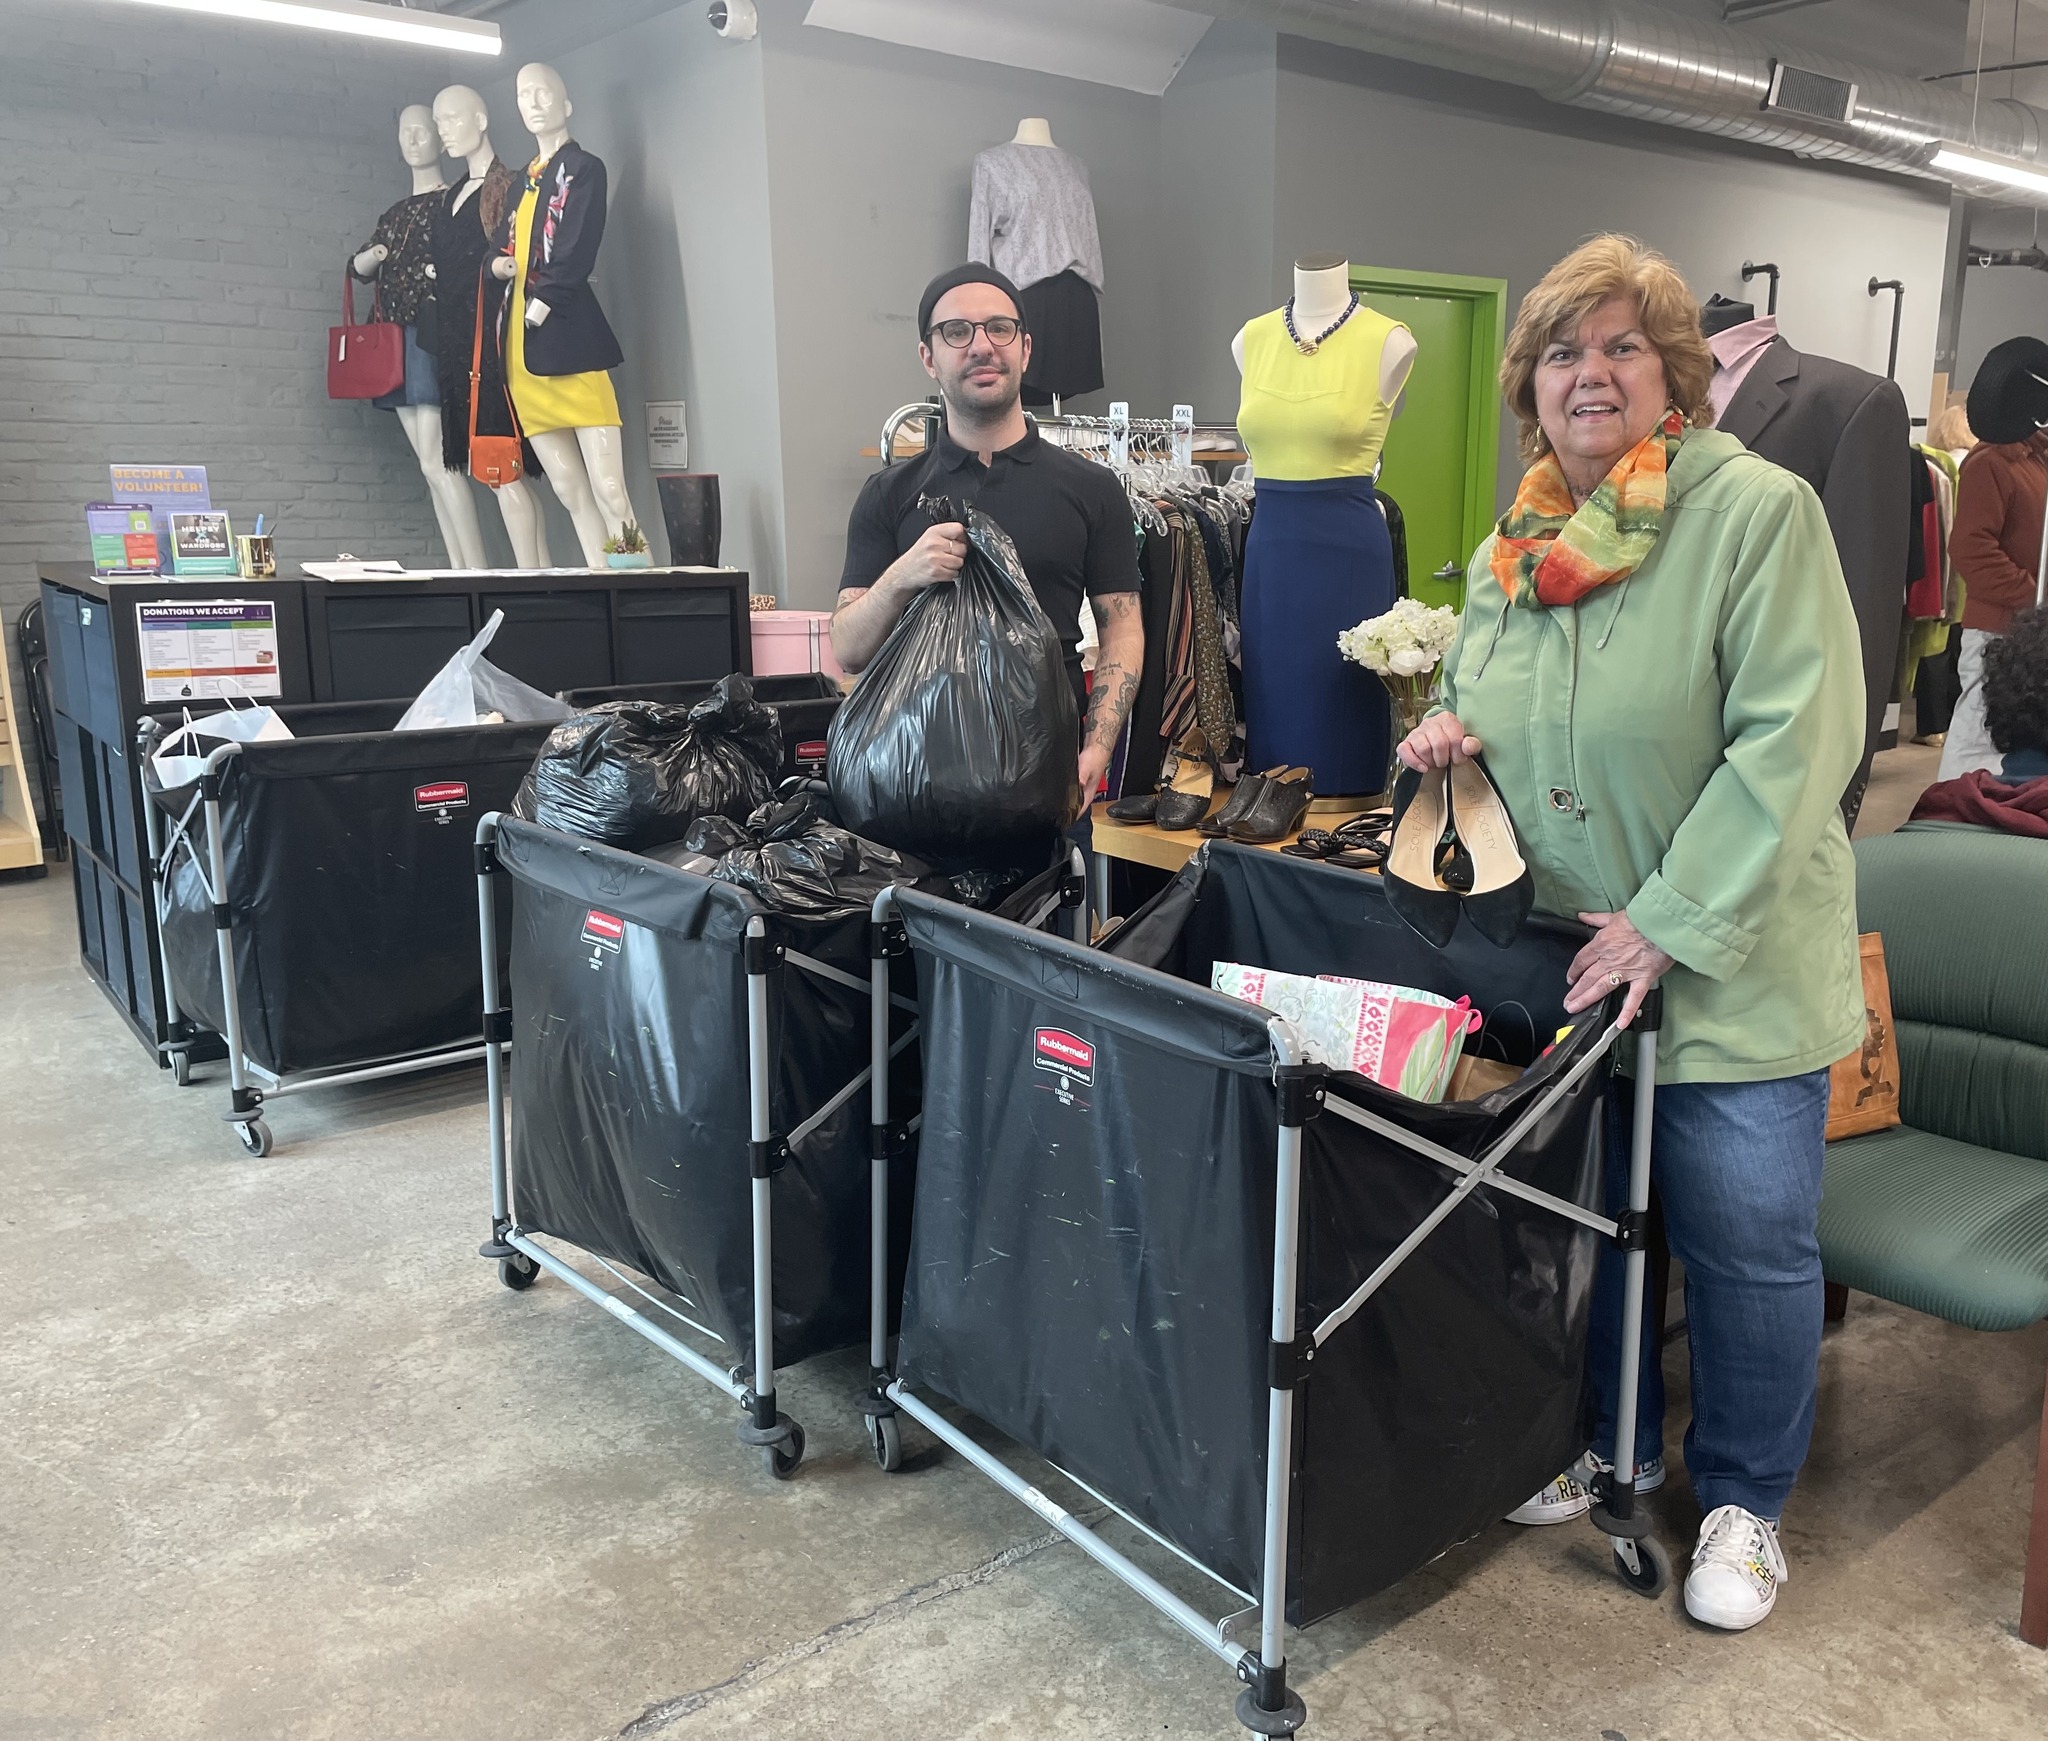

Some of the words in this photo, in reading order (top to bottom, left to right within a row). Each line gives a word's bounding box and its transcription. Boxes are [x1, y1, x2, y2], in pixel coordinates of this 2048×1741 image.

[1113, 407, 1124, 415] XL
[1175, 408, 1191, 418] XXL
[113, 469, 172, 479] BECOME
[175, 468, 185, 479] A
[115, 482, 203, 493] VOLUNTEER!
[143, 608, 195, 616] DONATIONS
[195, 608, 211, 616] WE
[212, 607, 244, 616] ACCEPT
[420, 788, 463, 798] Rubbermaid
[1464, 784, 1480, 806] SOLE
[1474, 809, 1497, 850] SOCIETY
[1410, 825, 1422, 852] SOLE
[588, 915, 620, 933] Rubbermaid
[1040, 1036, 1089, 1062] Rubbermaid
[1036, 1057, 1068, 1072] Commercial
[1068, 1066, 1091, 1082] Products
